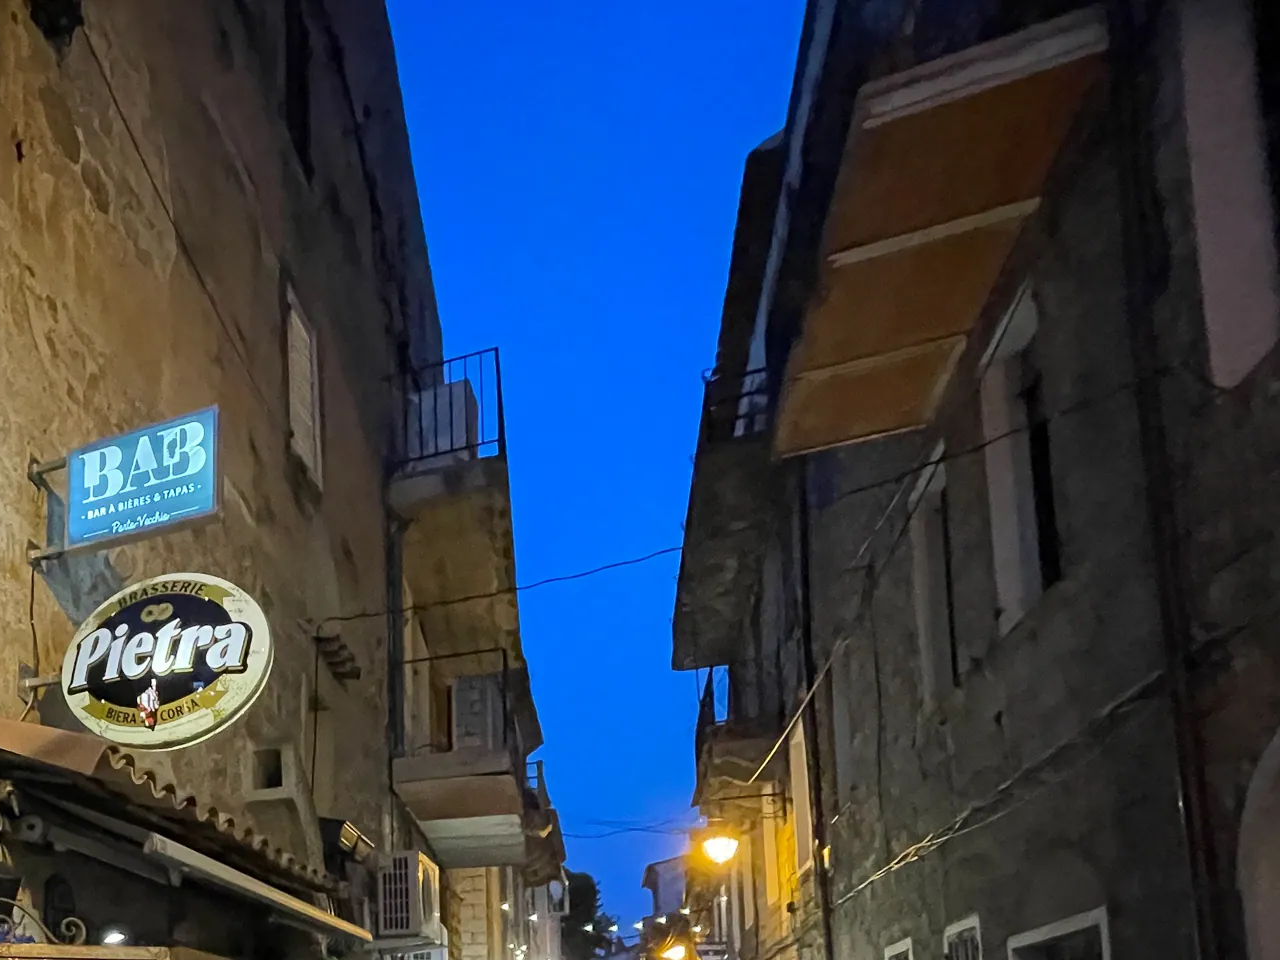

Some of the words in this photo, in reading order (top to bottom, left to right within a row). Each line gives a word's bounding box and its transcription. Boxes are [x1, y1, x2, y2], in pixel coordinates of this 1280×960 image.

[79, 422, 207, 504] BAB
[87, 505, 107, 520] BAR
[117, 493, 151, 511] BIÈRES
[153, 492, 161, 503] &
[163, 483, 195, 499] TAPAS
[117, 580, 208, 609] BRASSERIE
[68, 617, 251, 692] Pietra
[106, 706, 138, 725] BIERA
